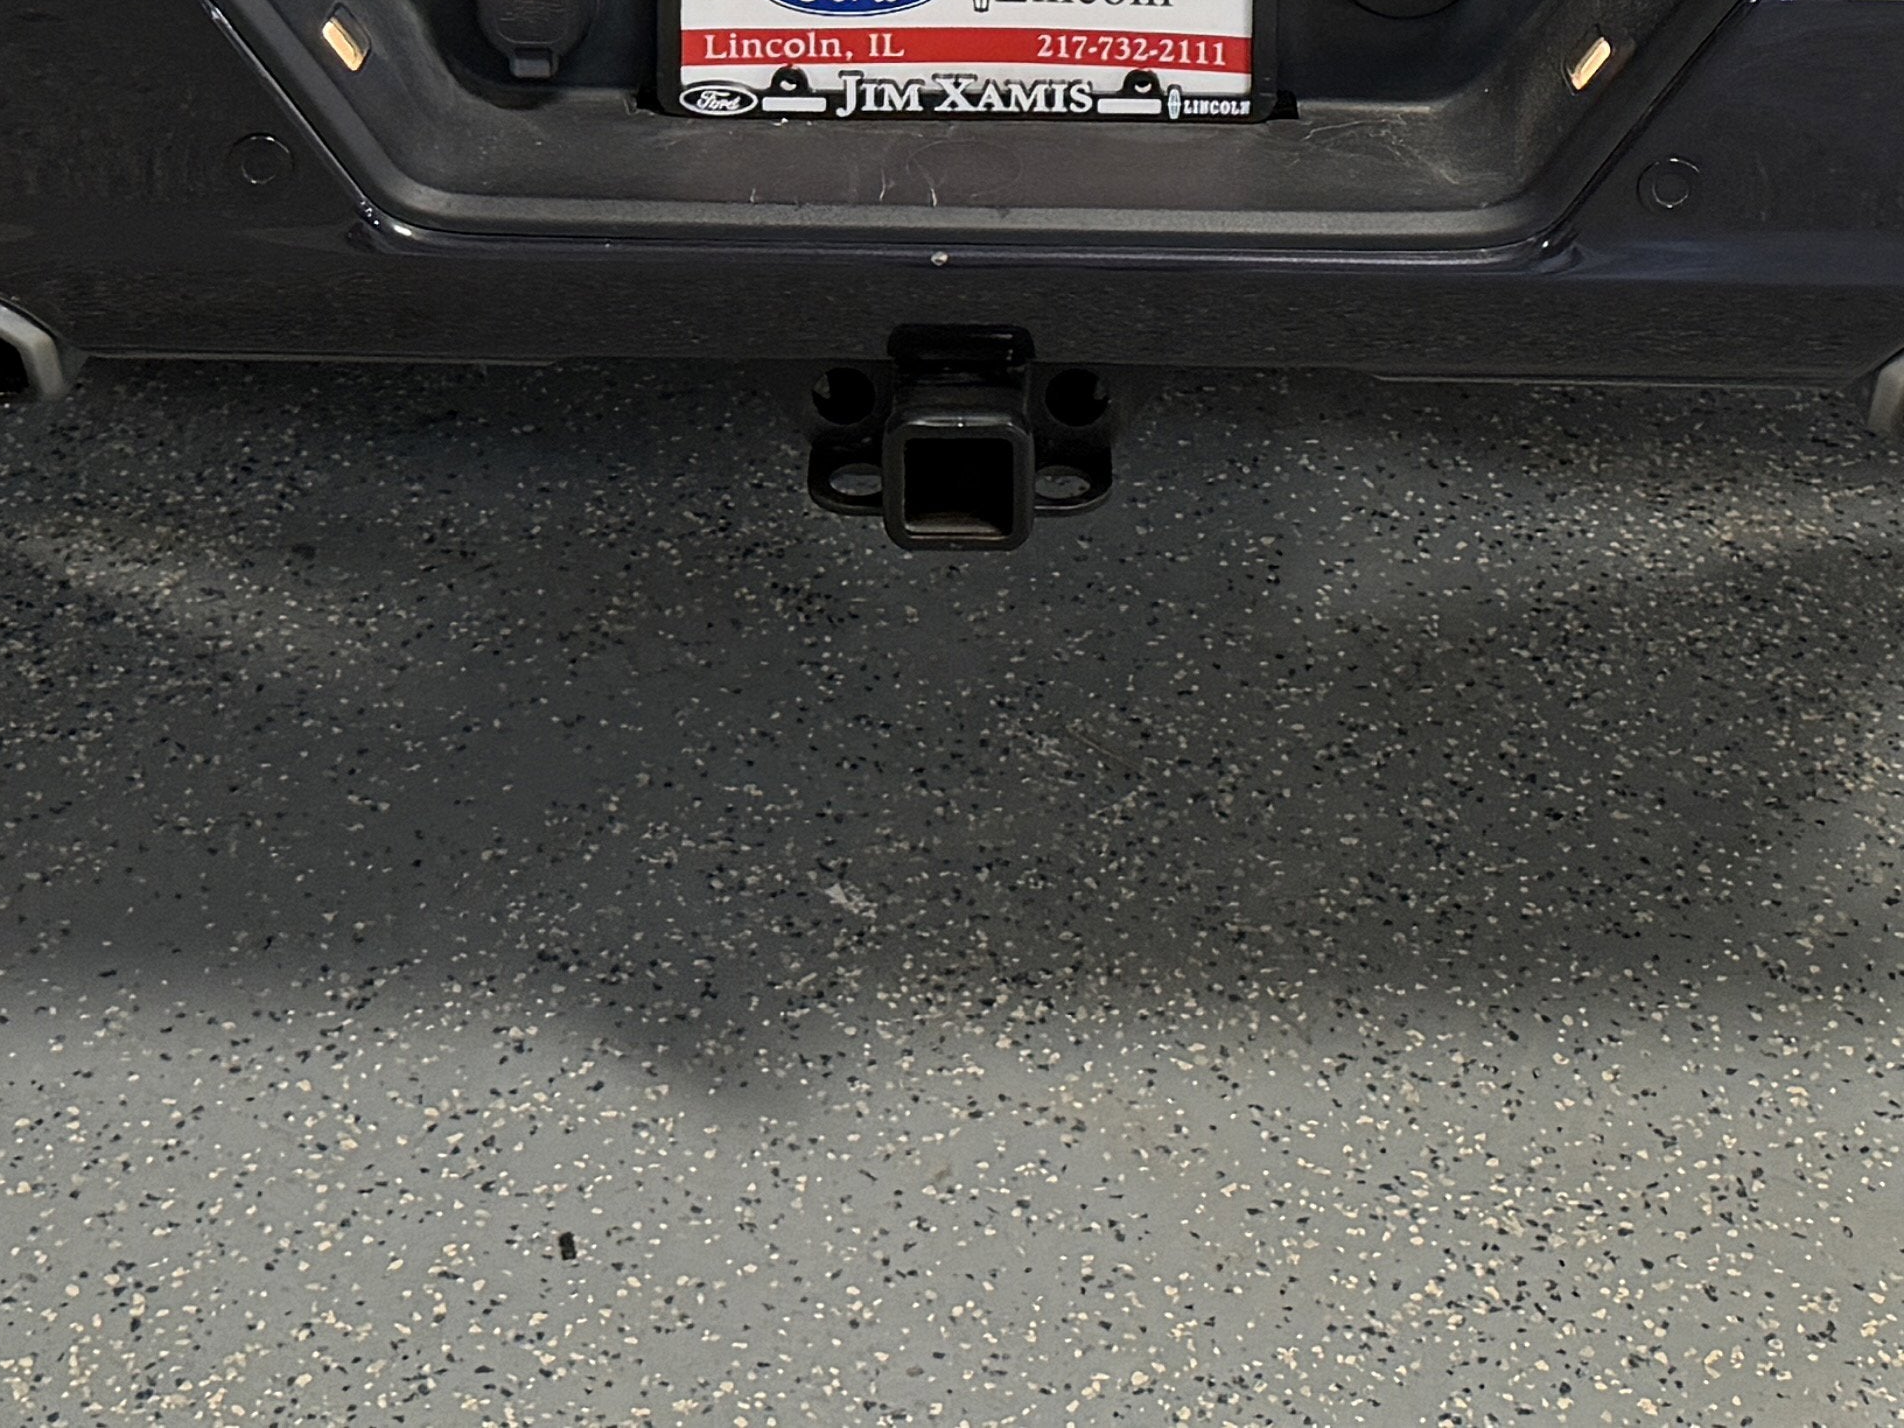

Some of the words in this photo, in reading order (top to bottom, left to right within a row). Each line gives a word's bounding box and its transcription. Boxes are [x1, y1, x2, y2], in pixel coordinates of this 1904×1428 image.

[703, 33, 854, 61] Lincoln,
[868, 34, 905, 59] IL
[1037, 33, 1227, 68] 217-732-2111
[837, 71, 925, 118] JIM
[934, 73, 1095, 115] XAMIS
[1183, 99, 1251, 115] LINCOLN
